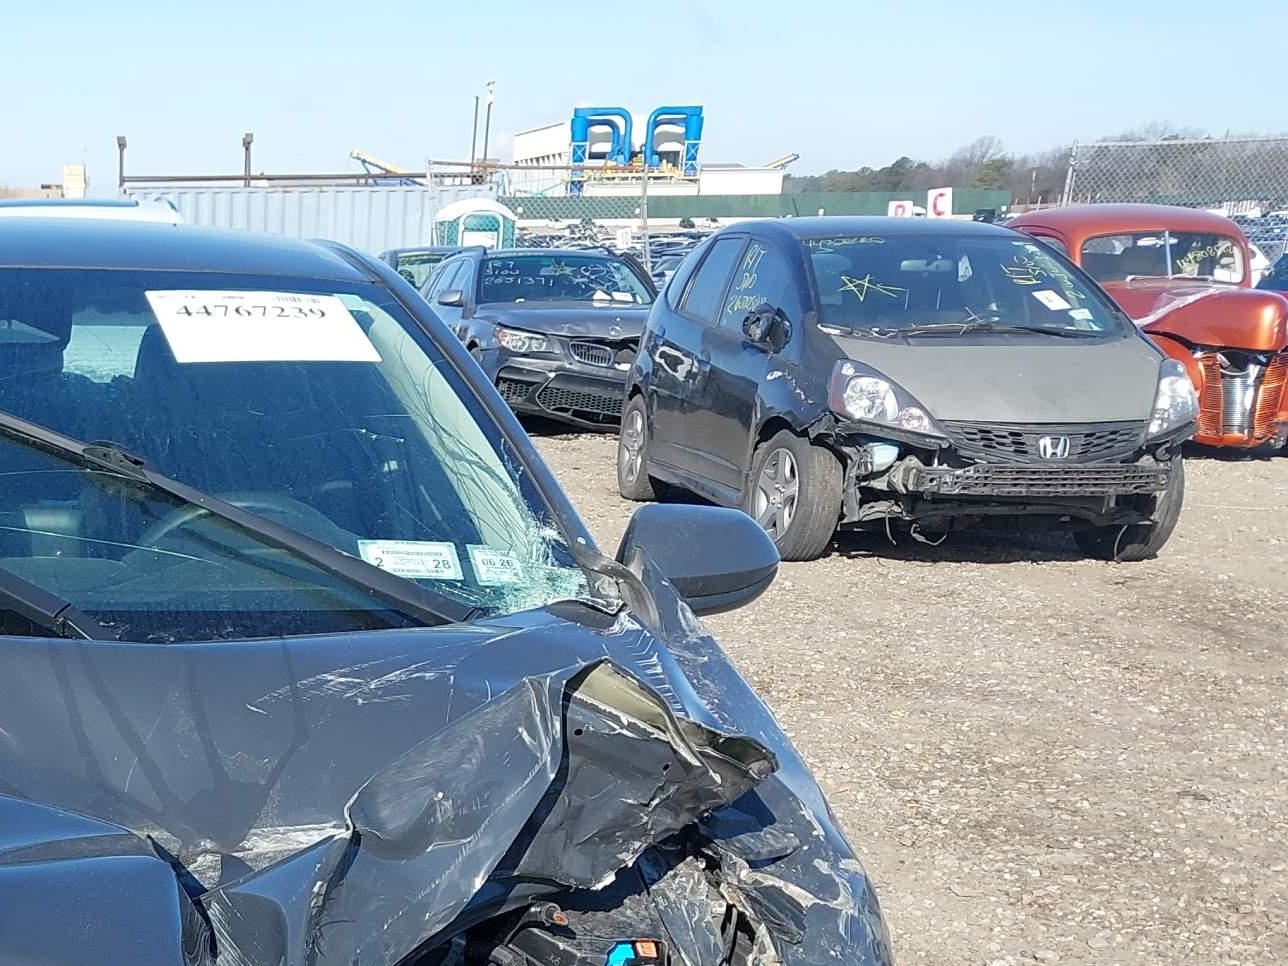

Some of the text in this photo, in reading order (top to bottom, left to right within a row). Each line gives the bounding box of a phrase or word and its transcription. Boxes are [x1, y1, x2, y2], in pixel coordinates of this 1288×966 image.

[933, 192, 946, 217] C
[175, 304, 327, 319] 44767239
[432, 559, 451, 570] 28
[499, 558, 514, 568] 26
